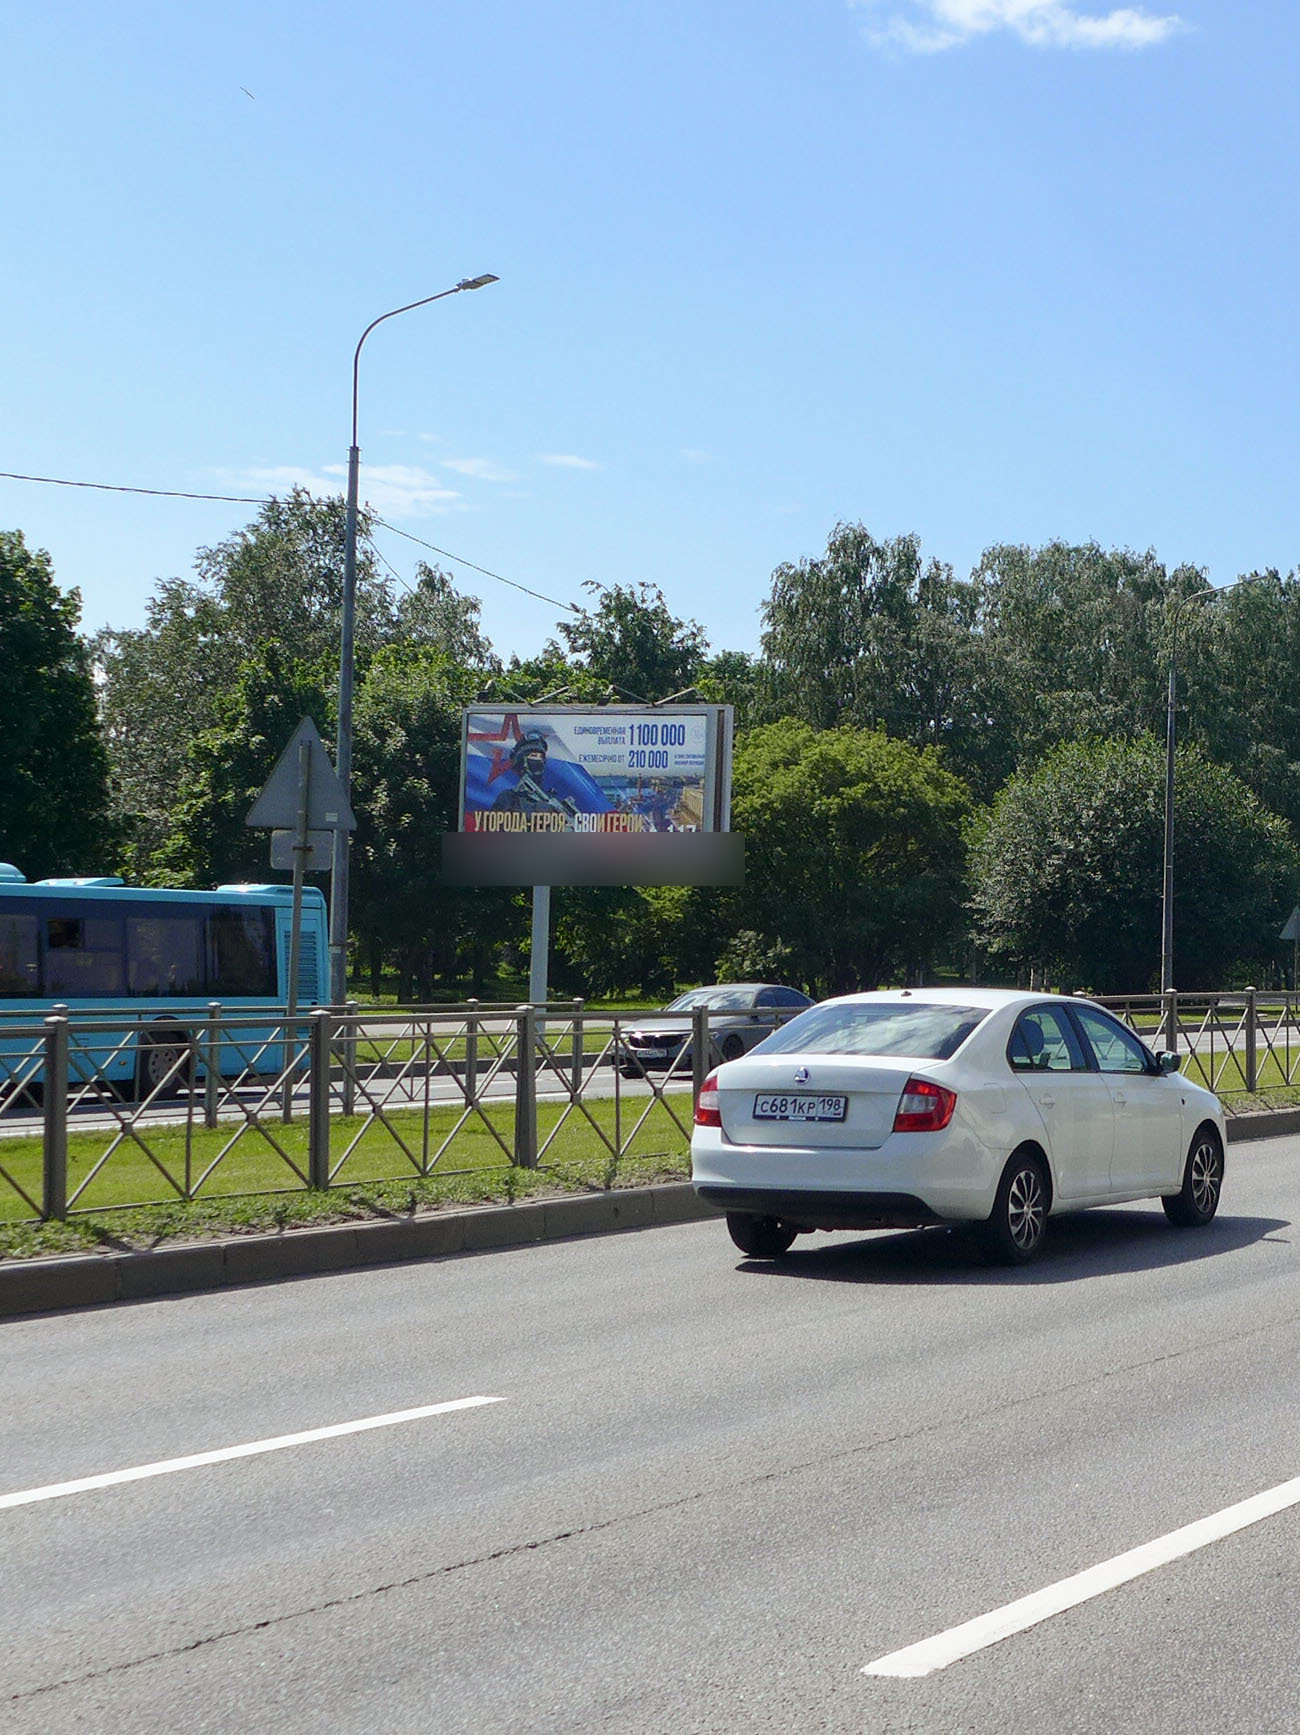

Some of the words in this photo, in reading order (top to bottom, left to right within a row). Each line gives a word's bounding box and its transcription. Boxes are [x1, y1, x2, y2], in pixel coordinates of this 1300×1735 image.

[628, 750, 646, 768] 210
[648, 750, 668, 768] 000
[484, 812, 564, 832] ГОРОДА-ГЕРОЯ
